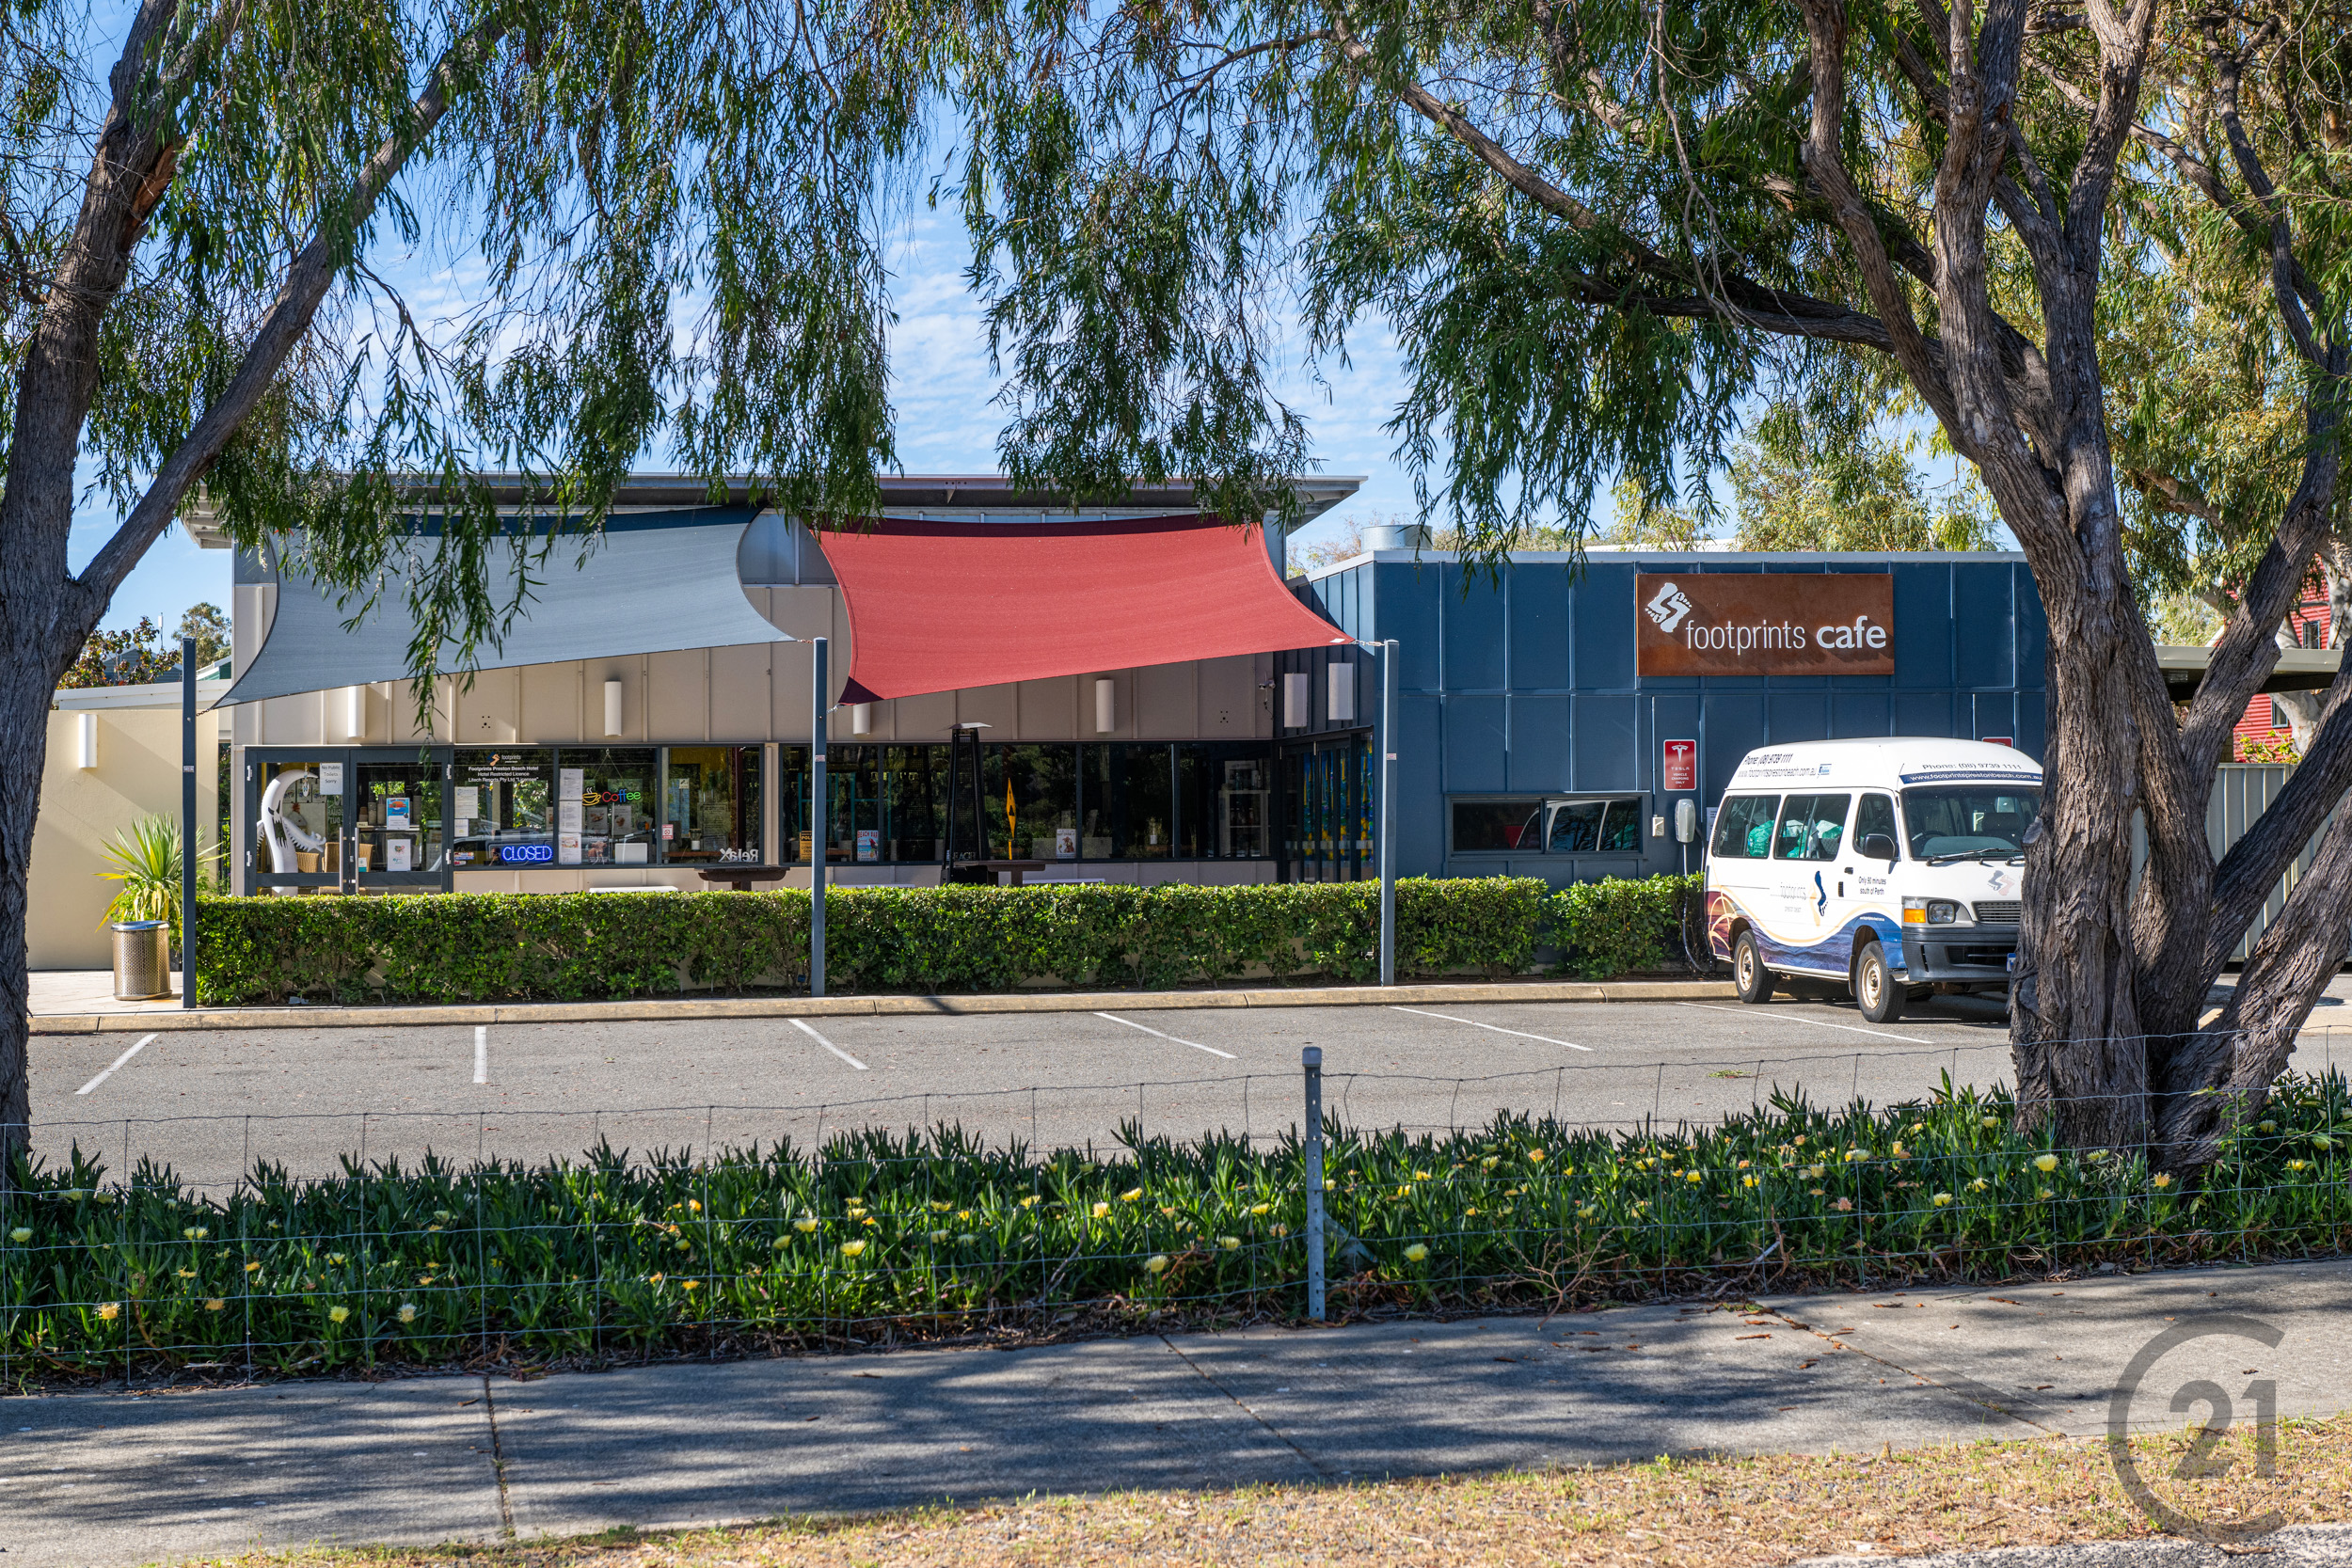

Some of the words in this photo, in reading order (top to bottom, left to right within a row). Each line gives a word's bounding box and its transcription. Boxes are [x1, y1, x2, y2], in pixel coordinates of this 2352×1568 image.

[1685, 619, 1806, 656] footprints
[1816, 615, 1886, 649] cafe
[602, 788, 642, 803] Coffee
[501, 845, 553, 862] CLOSED
[1858, 877, 1867, 885] Only
[1874, 887, 1884, 895] Perth
